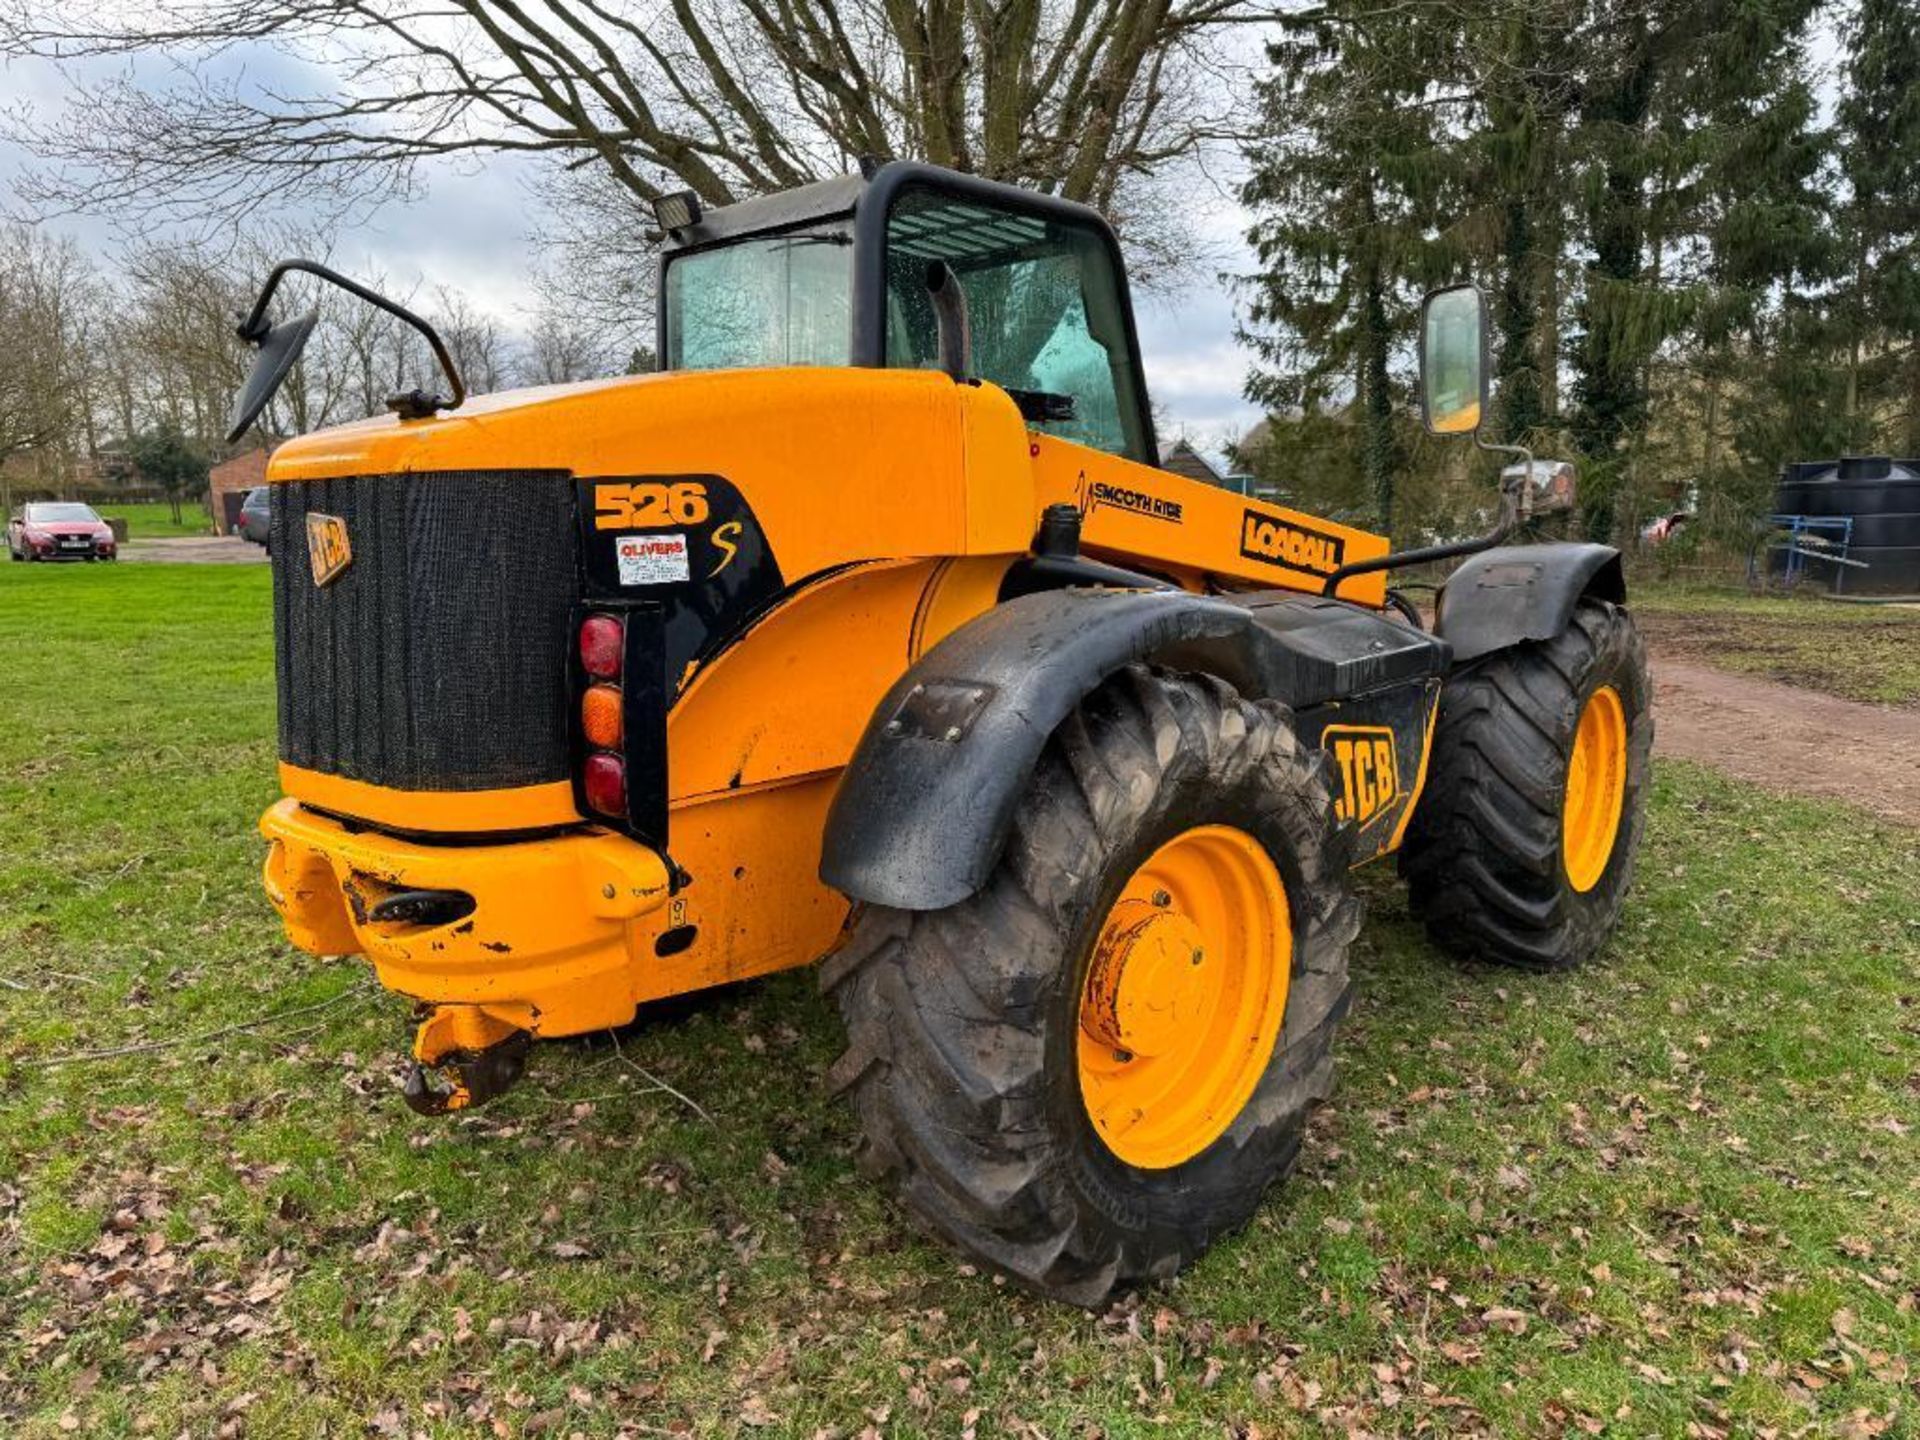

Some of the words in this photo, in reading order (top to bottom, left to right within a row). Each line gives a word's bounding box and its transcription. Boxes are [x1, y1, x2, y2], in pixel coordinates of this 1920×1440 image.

[1094, 482, 1151, 512] SMOOTH
[1153, 498, 1182, 519] RIDE
[595, 482, 709, 530] 526
[706, 521, 742, 579] S
[620, 541, 684, 558] OLIVERS
[1243, 515, 1340, 574] LOADALL
[1335, 740, 1393, 822] JCB
